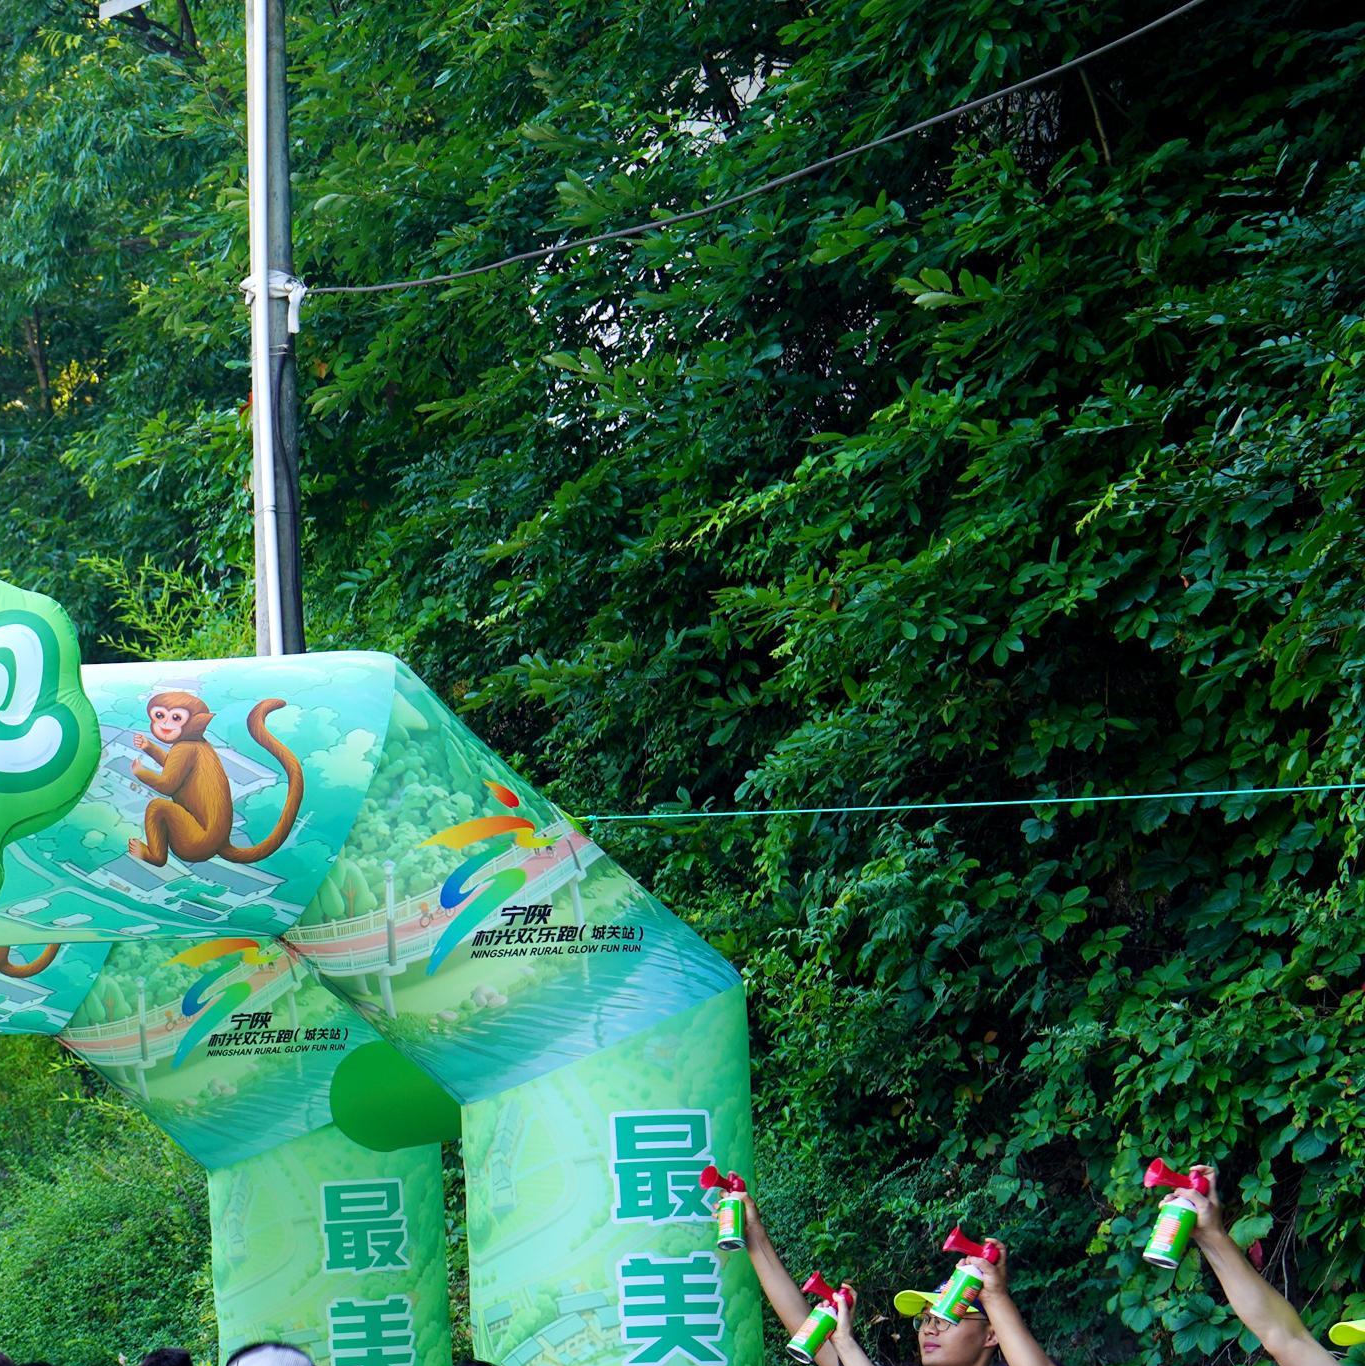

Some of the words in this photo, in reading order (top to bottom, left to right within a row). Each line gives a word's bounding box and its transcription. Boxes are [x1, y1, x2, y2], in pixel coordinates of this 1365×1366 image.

[501, 904, 553, 926] 宁陕
[471, 947, 527, 959] NINGSHAN
[530, 946, 564, 956] RURAL
[567, 945, 598, 954] GLOW
[600, 944, 620, 953] FUN
[622, 944, 642, 953] RUN
[231, 1012, 273, 1030] 宁陕
[207, 1048, 252, 1057] NINGSHAN
[254, 1046, 282, 1055] RURAL
[284, 1045, 311, 1053] GLOW
[312, 1043, 328, 1051] FUN
[329, 1043, 346, 1051] RUN
